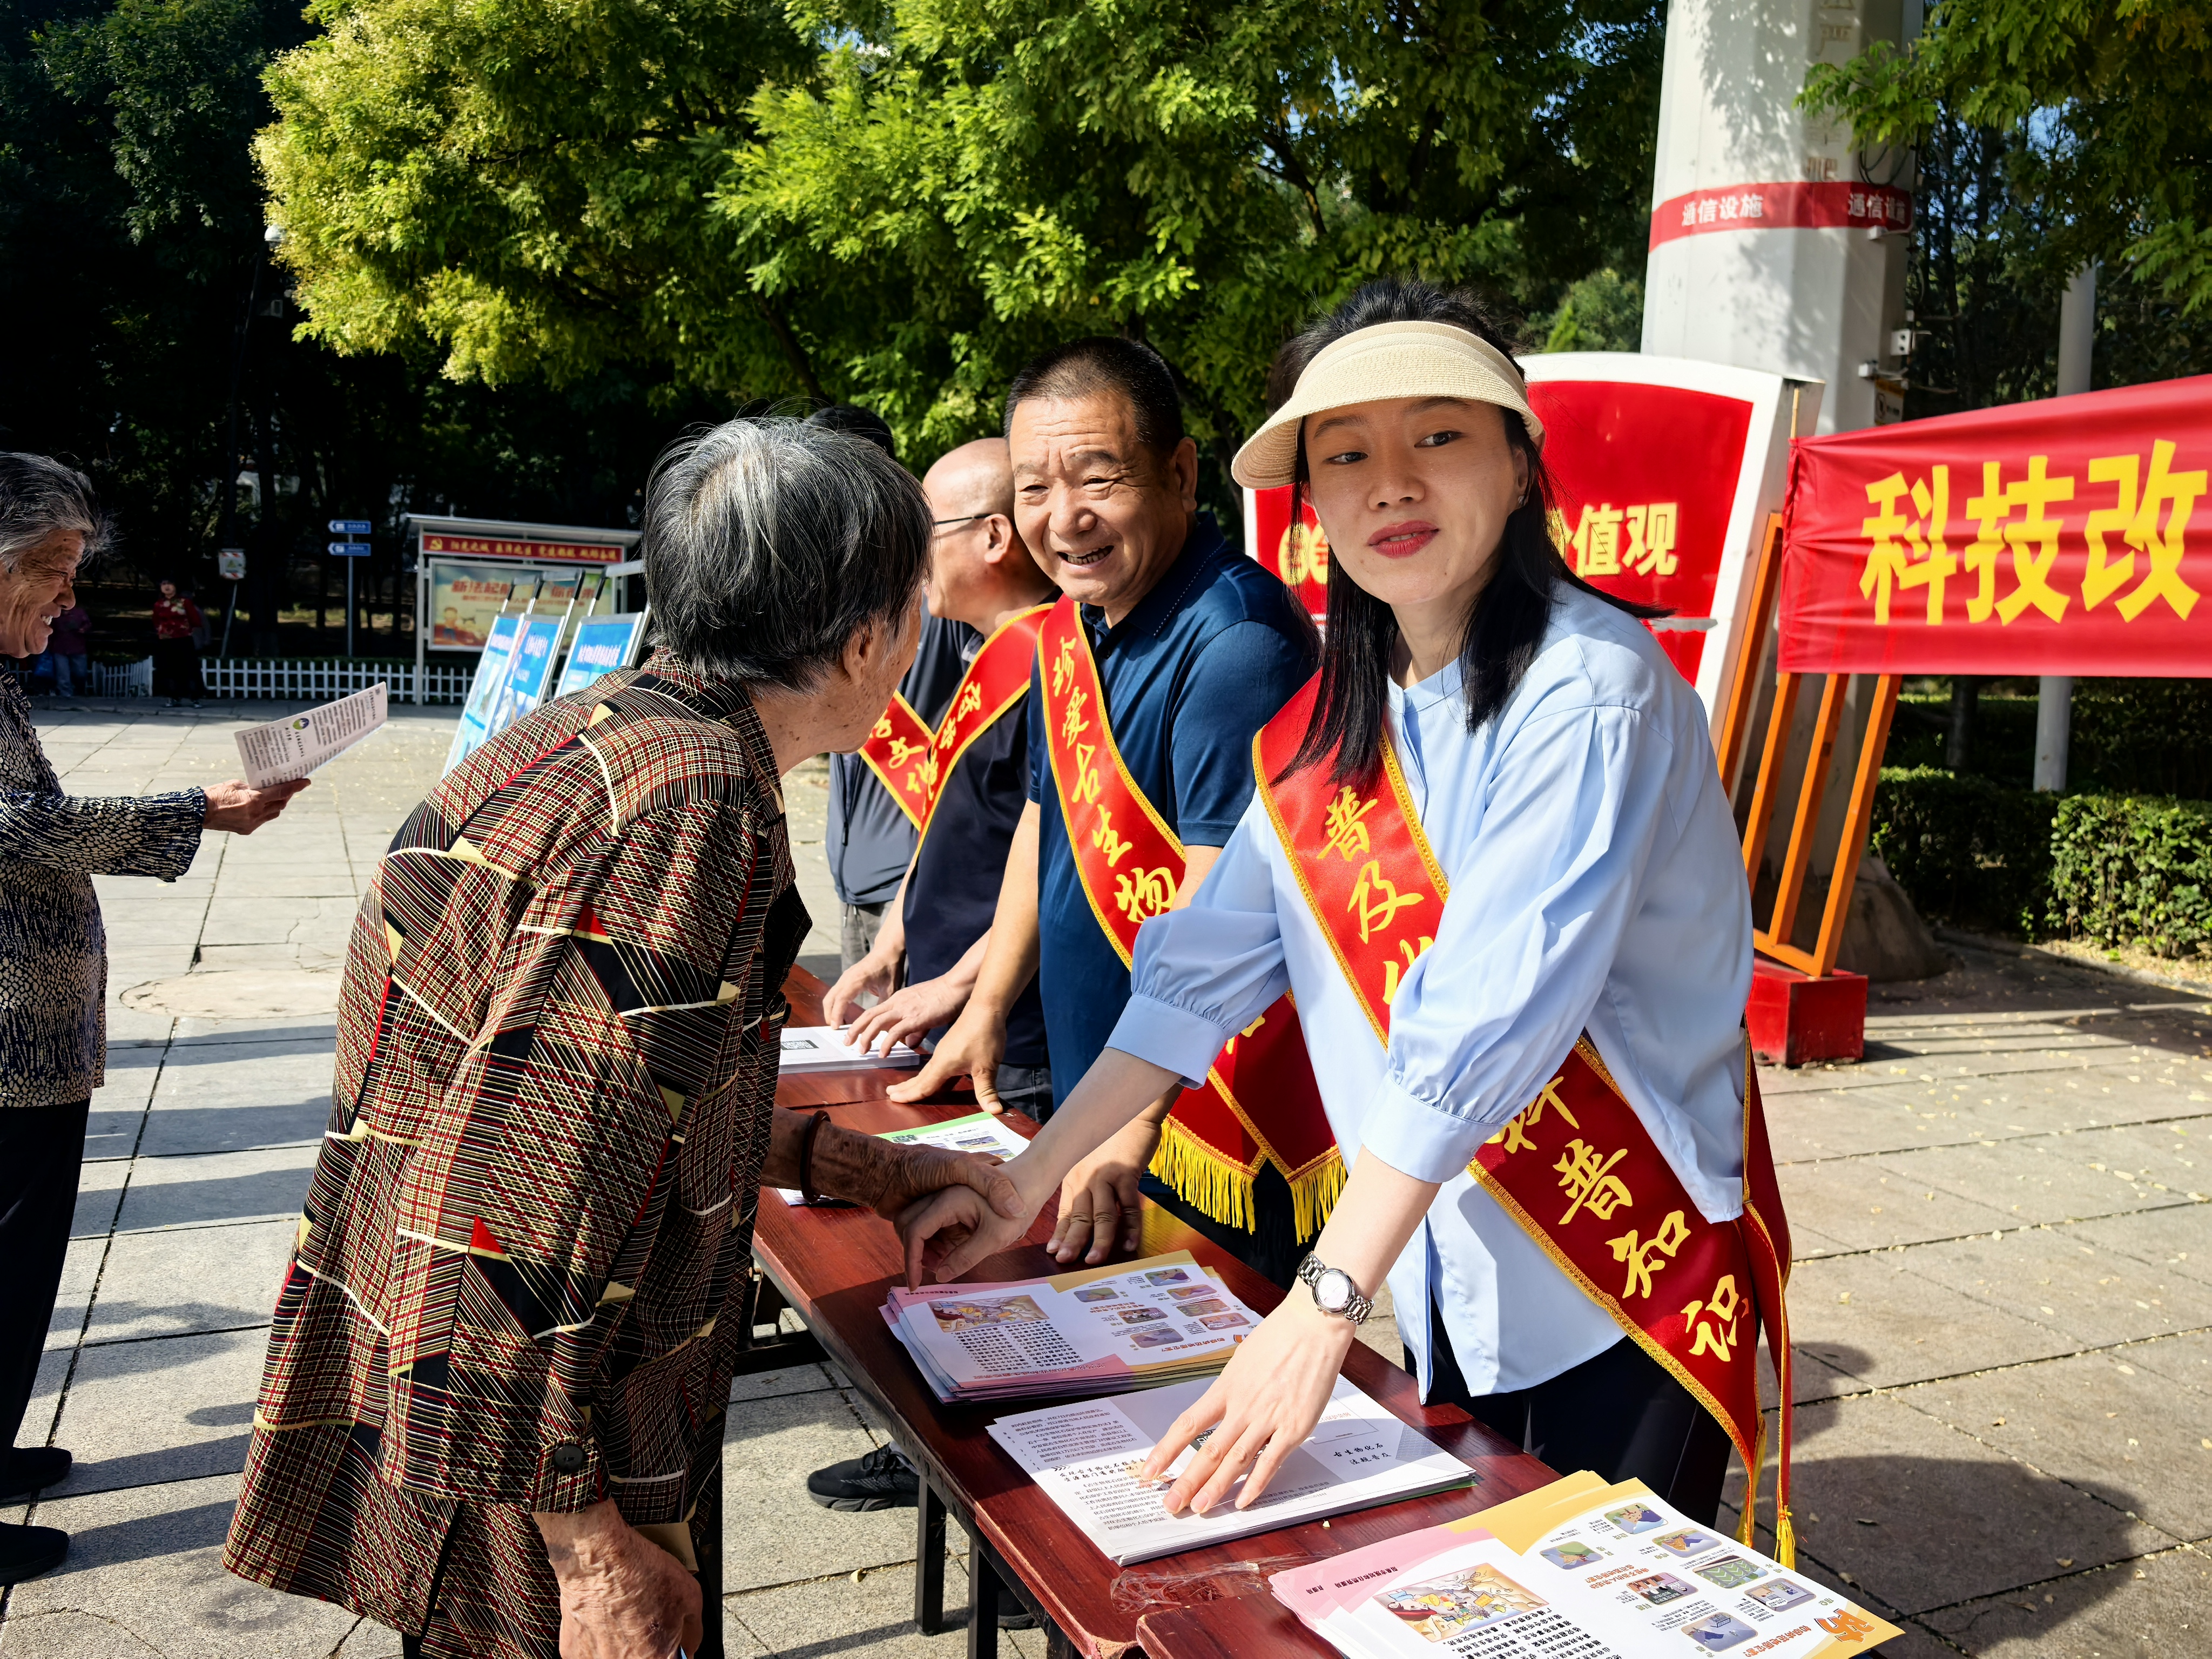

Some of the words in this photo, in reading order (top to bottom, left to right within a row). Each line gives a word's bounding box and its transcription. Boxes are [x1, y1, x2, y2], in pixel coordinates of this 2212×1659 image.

[1682, 193, 1764, 226] 通信设施
[1859, 439, 2208, 626] 科技改
[1051, 636, 1177, 924] 珍爱古生物
[1330, 1442, 1385, 1458] 古生物化石
[1347, 1452, 1392, 1465] 法规普及
[1333, 1566, 1398, 1588] 阳泉市规划和自然资源局
[1805, 1607, 1888, 1648] 防
